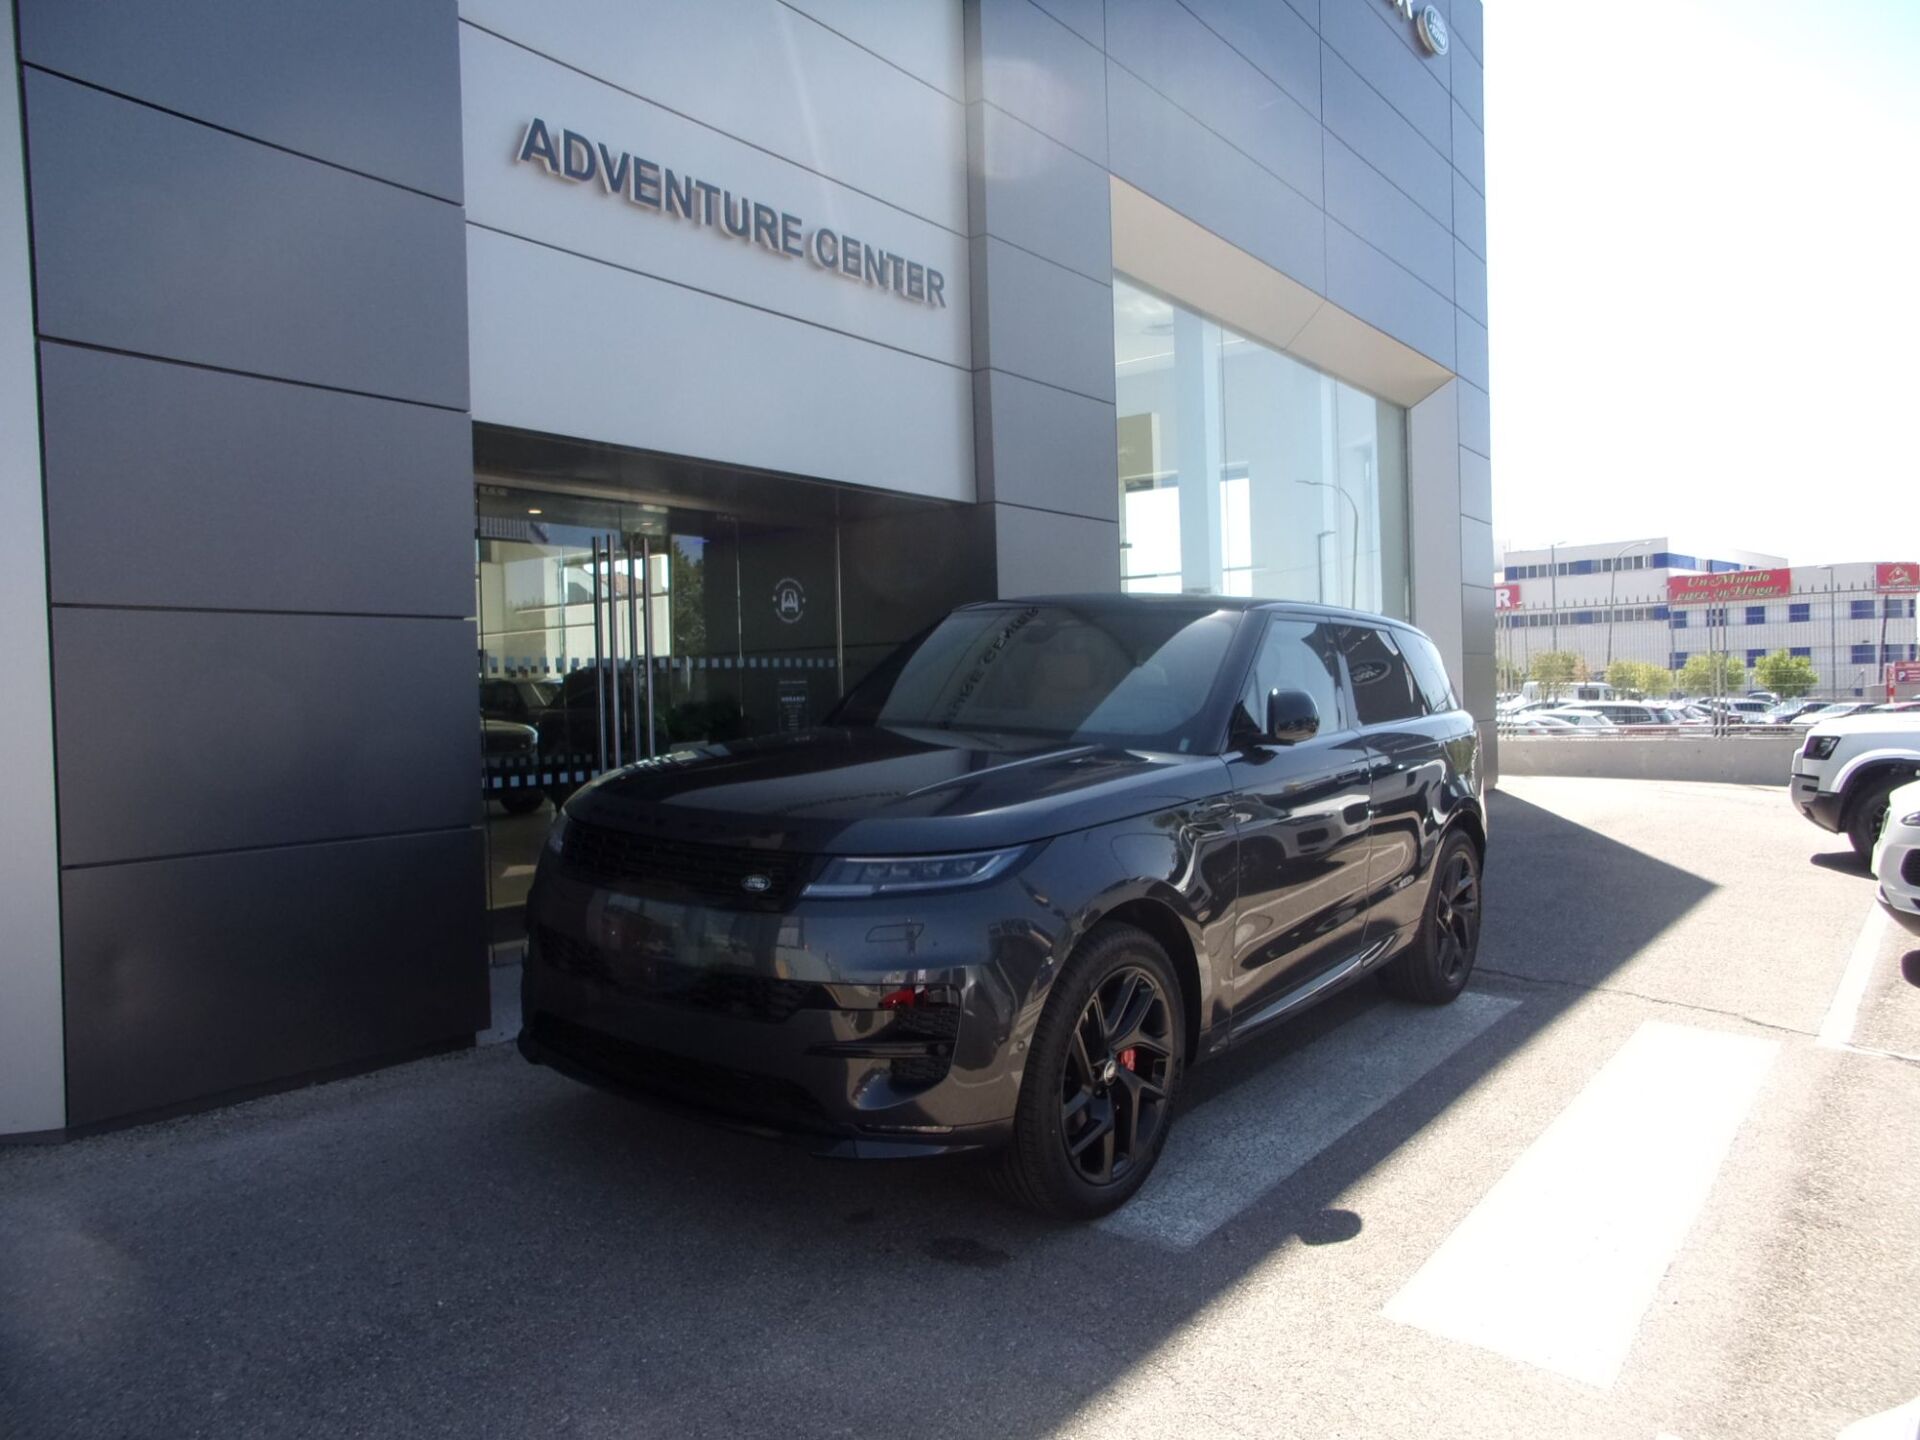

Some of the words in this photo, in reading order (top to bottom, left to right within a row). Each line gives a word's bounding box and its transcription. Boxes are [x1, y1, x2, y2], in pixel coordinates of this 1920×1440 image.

[517, 117, 804, 259] ADVENTURE
[811, 227, 946, 308] CENTER
[1709, 572, 1770, 587] Mundo
[1495, 588, 1511, 608] R
